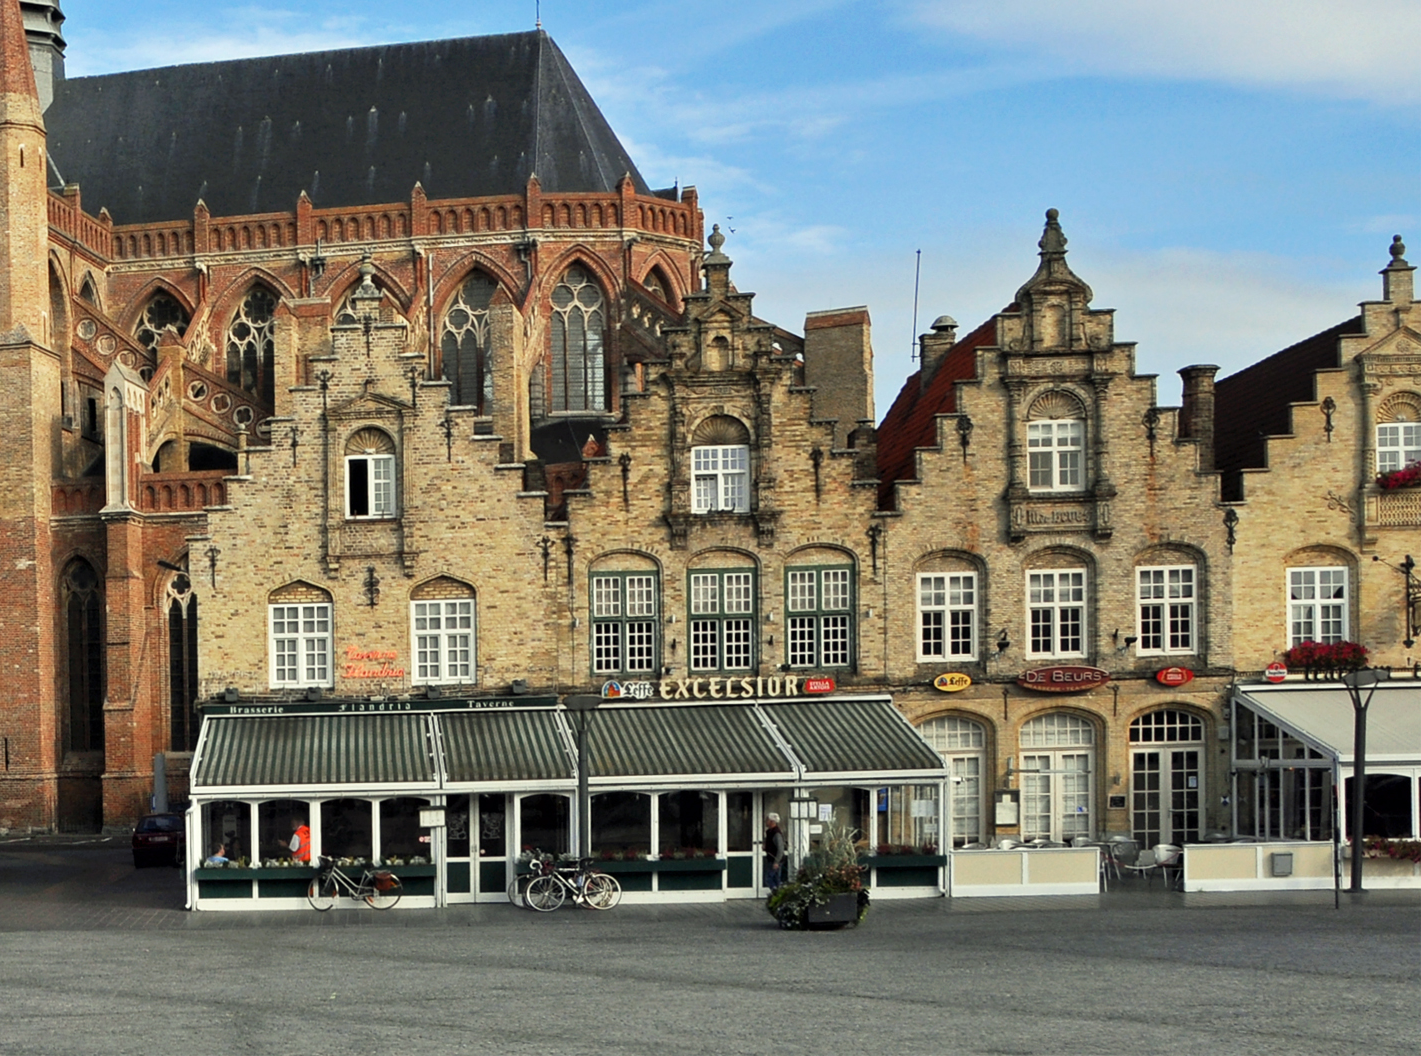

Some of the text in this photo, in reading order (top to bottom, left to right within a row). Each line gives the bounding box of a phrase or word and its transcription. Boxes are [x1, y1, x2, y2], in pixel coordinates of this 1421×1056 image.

[622, 682, 654, 698] Leffe
[659, 676, 798, 700] EXCELSIOR
[230, 706, 284, 714] Brasserie
[467, 700, 514, 708] Taverne
